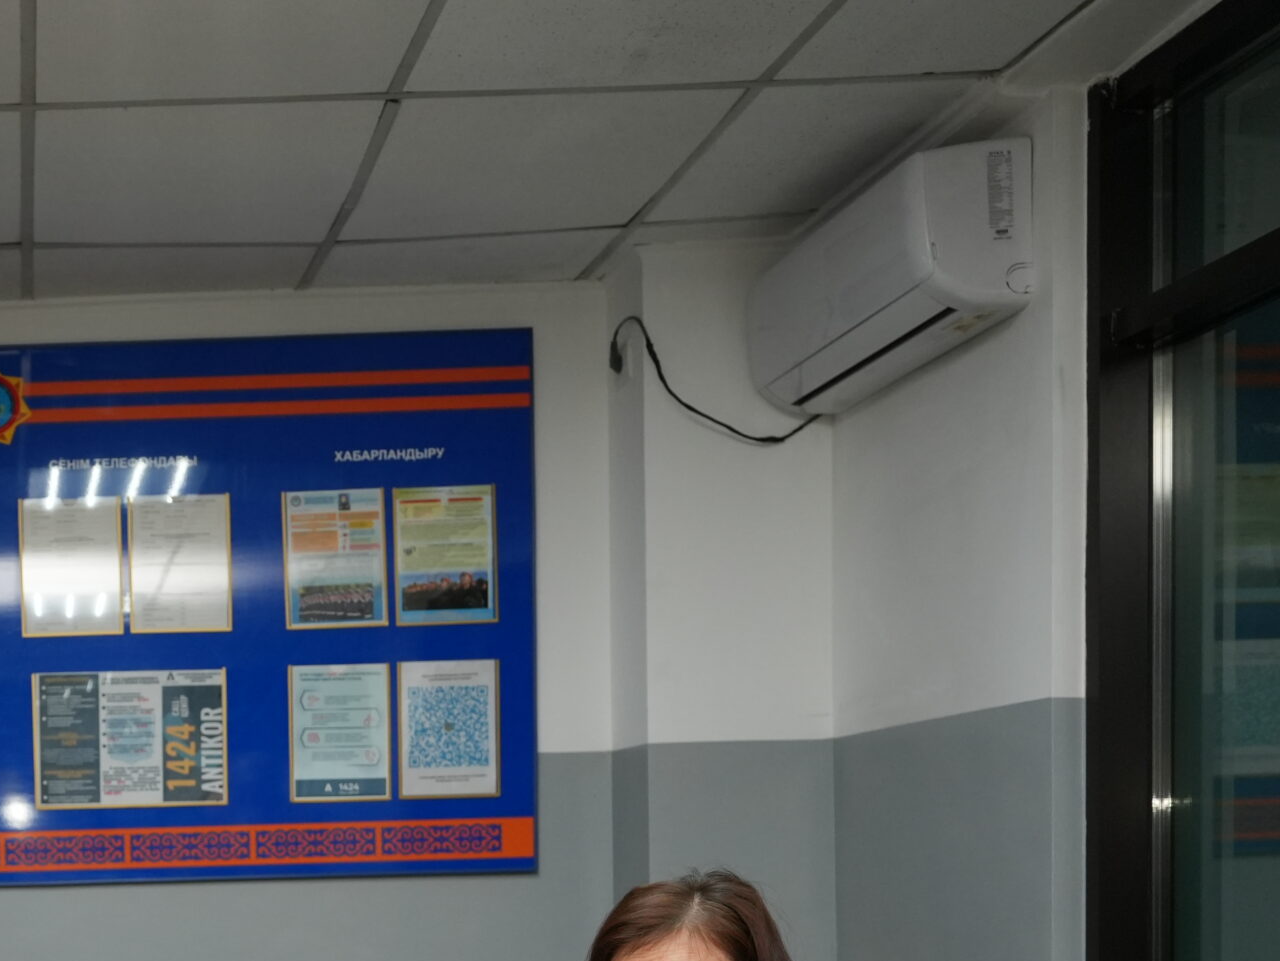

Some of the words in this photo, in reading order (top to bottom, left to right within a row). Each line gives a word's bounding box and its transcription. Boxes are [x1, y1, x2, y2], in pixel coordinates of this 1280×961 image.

[335, 447, 445, 462] ХАБАРЛАНДЫРУ
[165, 723, 197, 792] 1424
[200, 707, 223, 794] ANTIKOR
